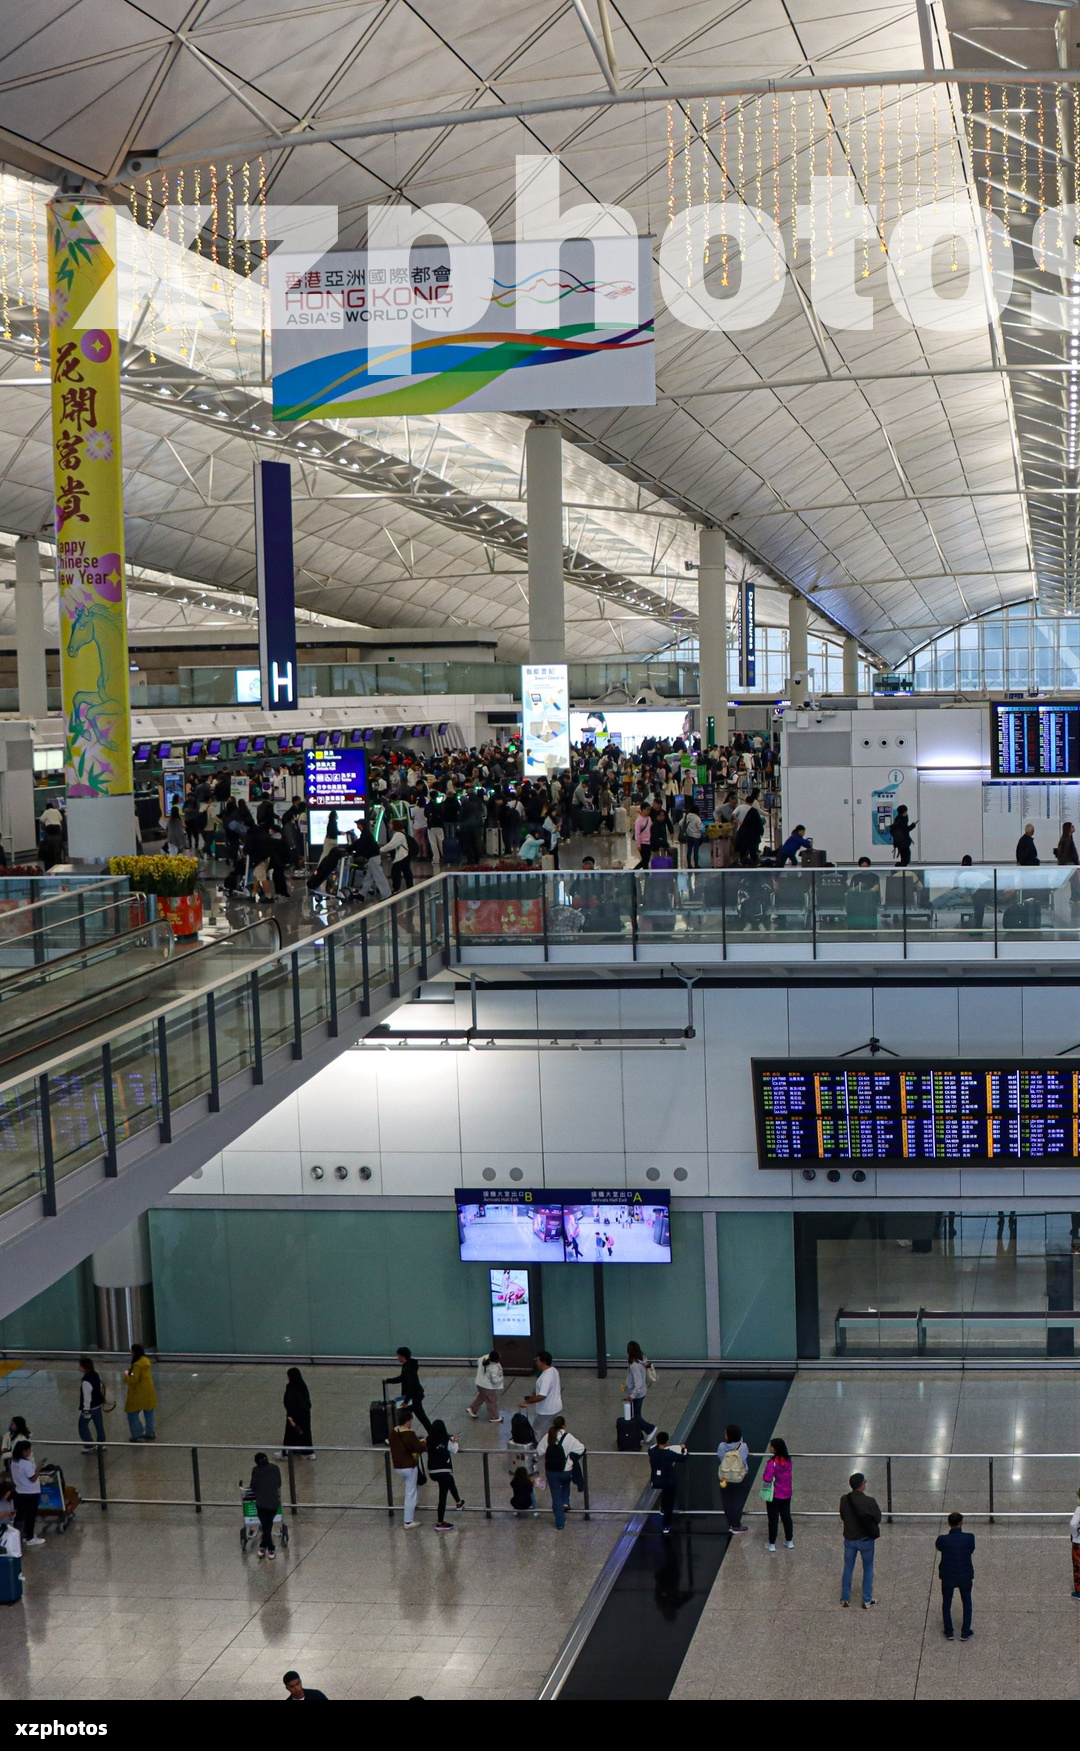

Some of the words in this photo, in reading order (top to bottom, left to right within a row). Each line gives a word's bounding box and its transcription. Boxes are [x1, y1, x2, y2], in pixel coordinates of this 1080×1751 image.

[285, 289, 366, 311] HONG
[372, 285, 453, 307] KONG
[286, 312, 341, 325] ASIA'S
[346, 309, 408, 322] WORLD
[412, 307, 453, 319] CITY
[58, 539, 86, 557] appy
[58, 571, 75, 585] ew
[79, 570, 109, 585] Year
[272, 661, 293, 703] H
[525, 1192, 532, 1202] B
[633, 1192, 642, 1202] A
